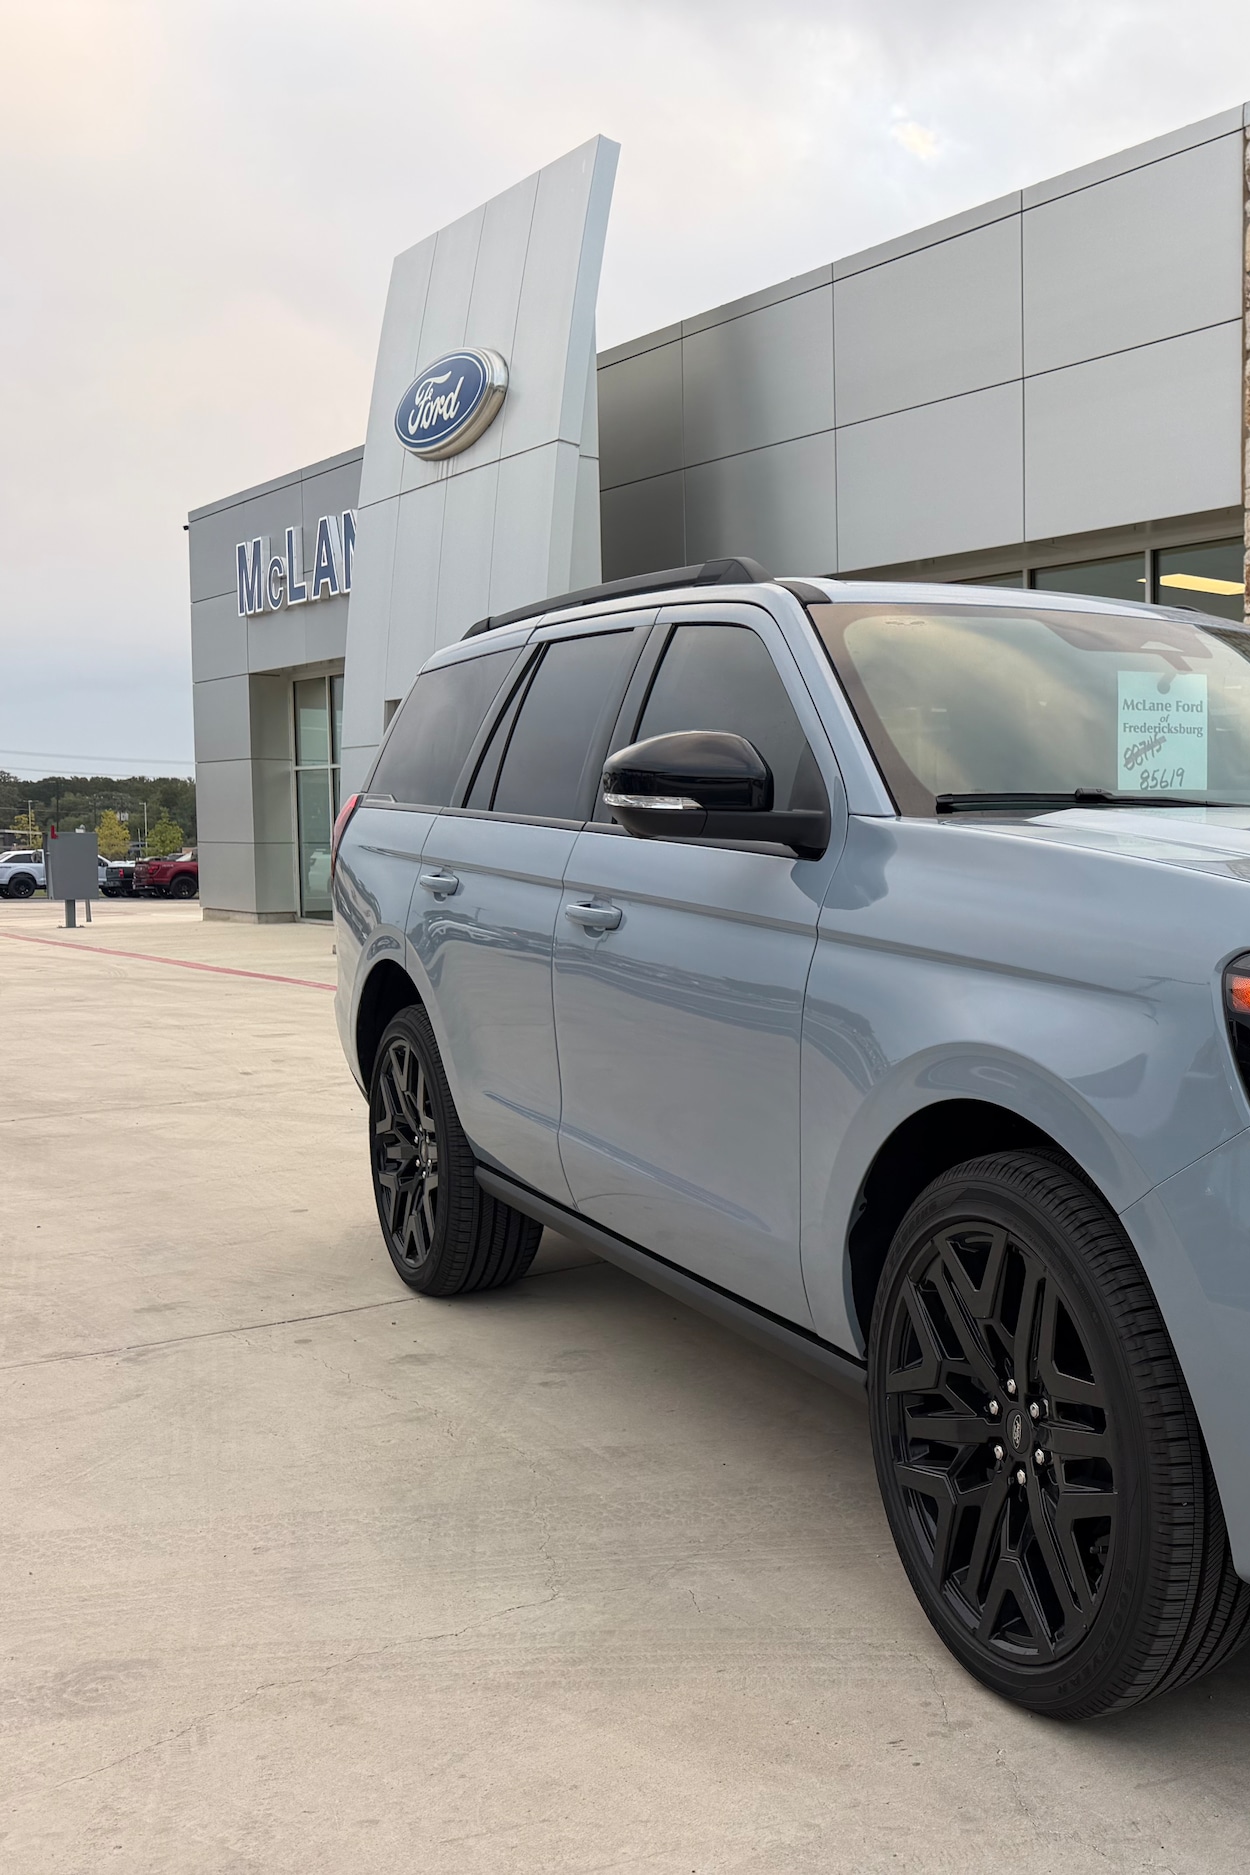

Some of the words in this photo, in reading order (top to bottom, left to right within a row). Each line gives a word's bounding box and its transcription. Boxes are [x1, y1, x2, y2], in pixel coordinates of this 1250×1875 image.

[408, 371, 465, 435] Ford
[1122, 698, 1172, 712] McLane
[1175, 700, 1203, 713] Ford
[1160, 714, 1170, 723] of
[1123, 722, 1204, 738] Fredericksburg
[1140, 767, 1185, 790] 85619
